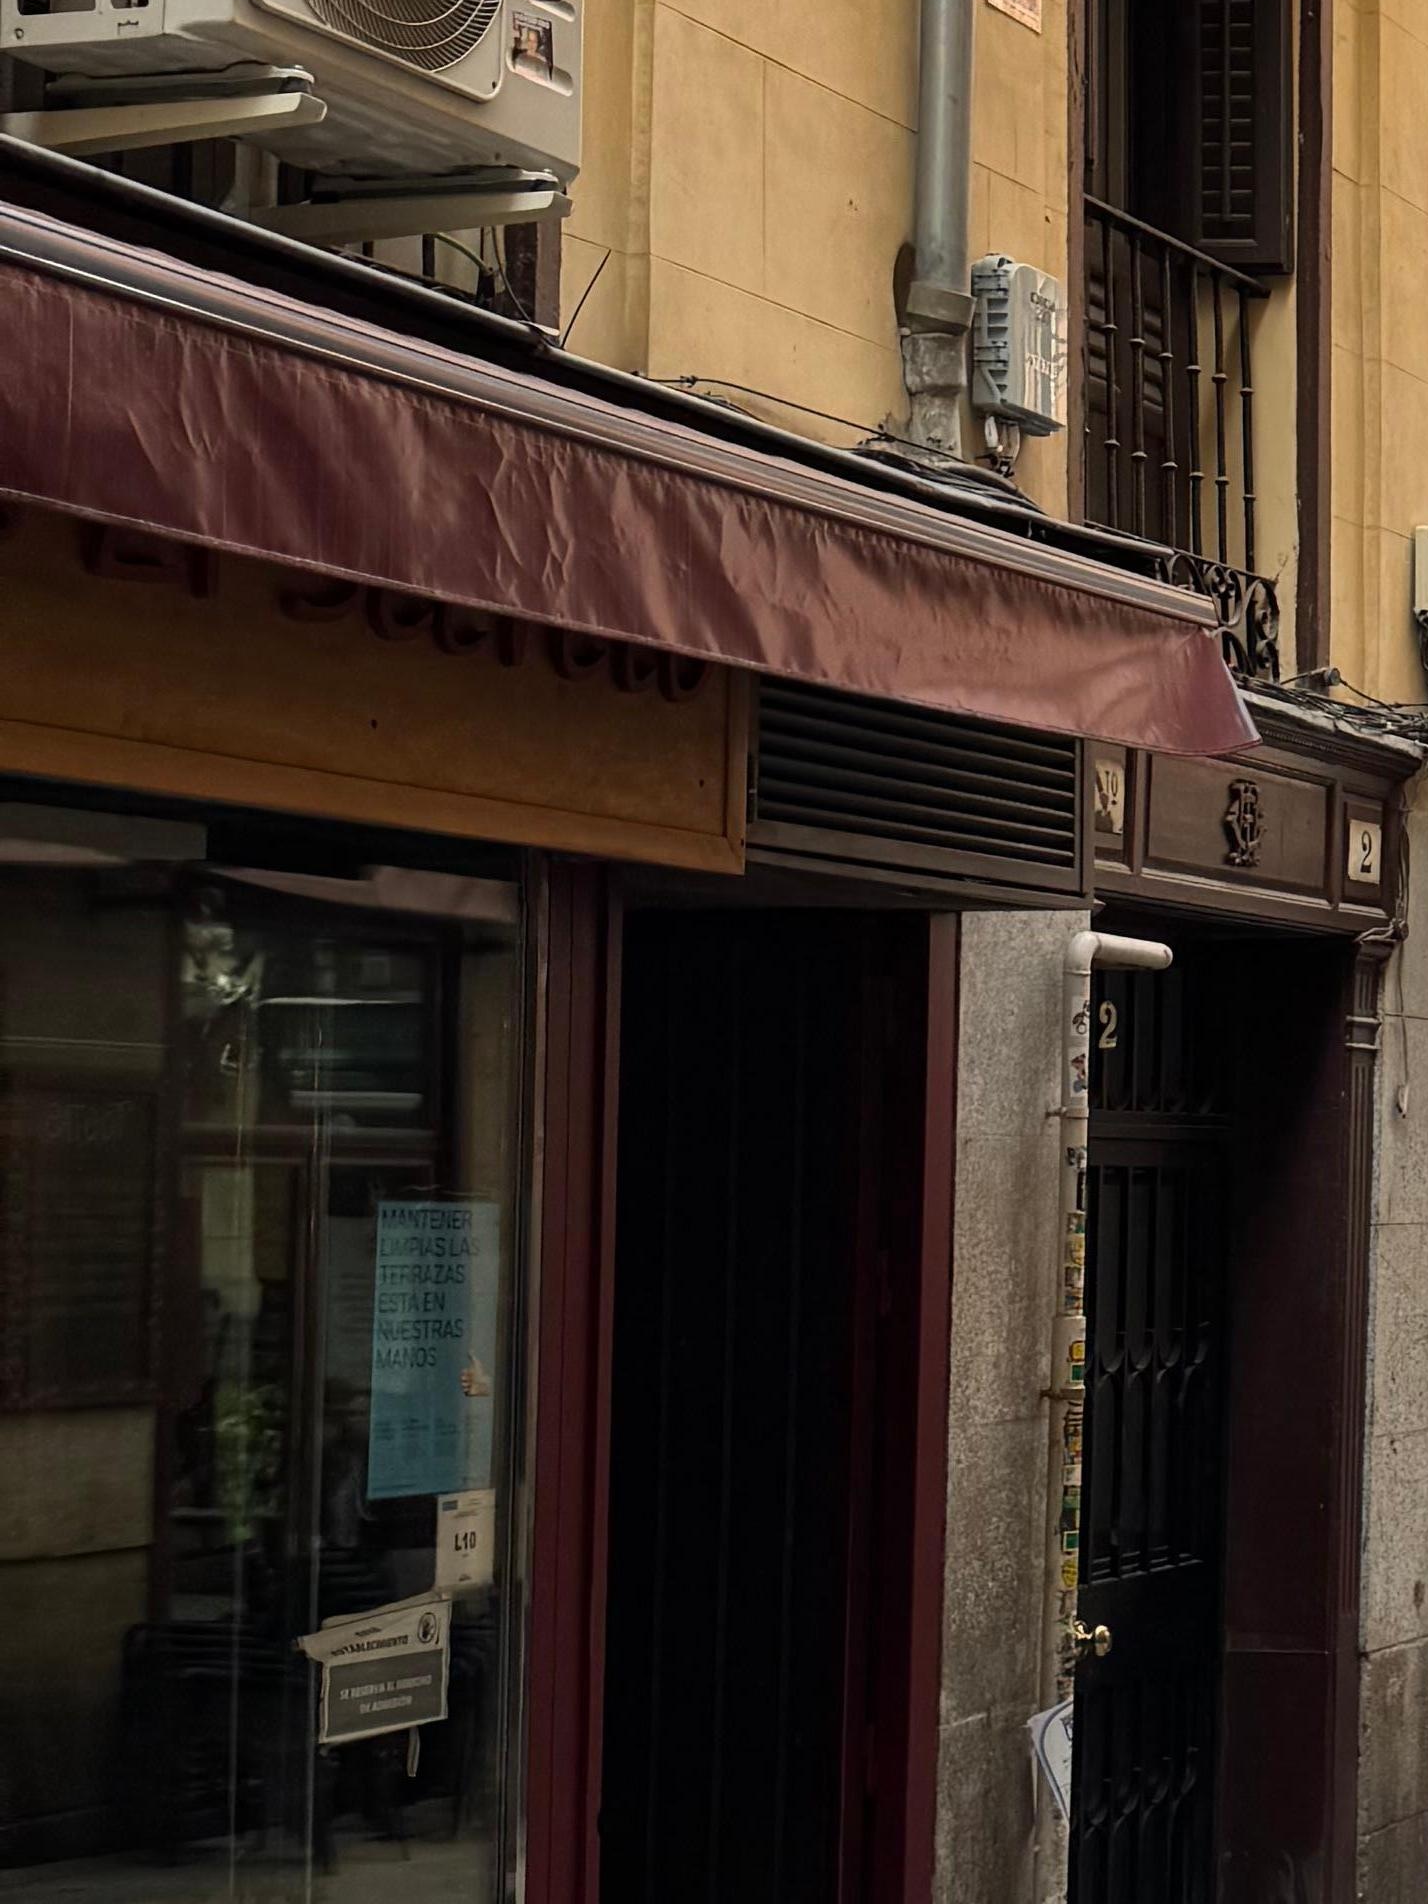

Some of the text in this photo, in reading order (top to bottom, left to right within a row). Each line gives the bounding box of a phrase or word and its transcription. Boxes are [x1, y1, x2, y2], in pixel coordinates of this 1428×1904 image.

[1361, 830, 1373, 874] 2
[1099, 1000, 1118, 1049] 2
[382, 1208, 472, 1230] MANTENER
[380, 1237, 480, 1258] LIMPIAS LAS
[380, 1264, 465, 1284] TERRAZAS
[423, 1291, 445, 1312] EN
[379, 1318, 464, 1341] NUESTRAS
[376, 1347, 437, 1369] MANOS
